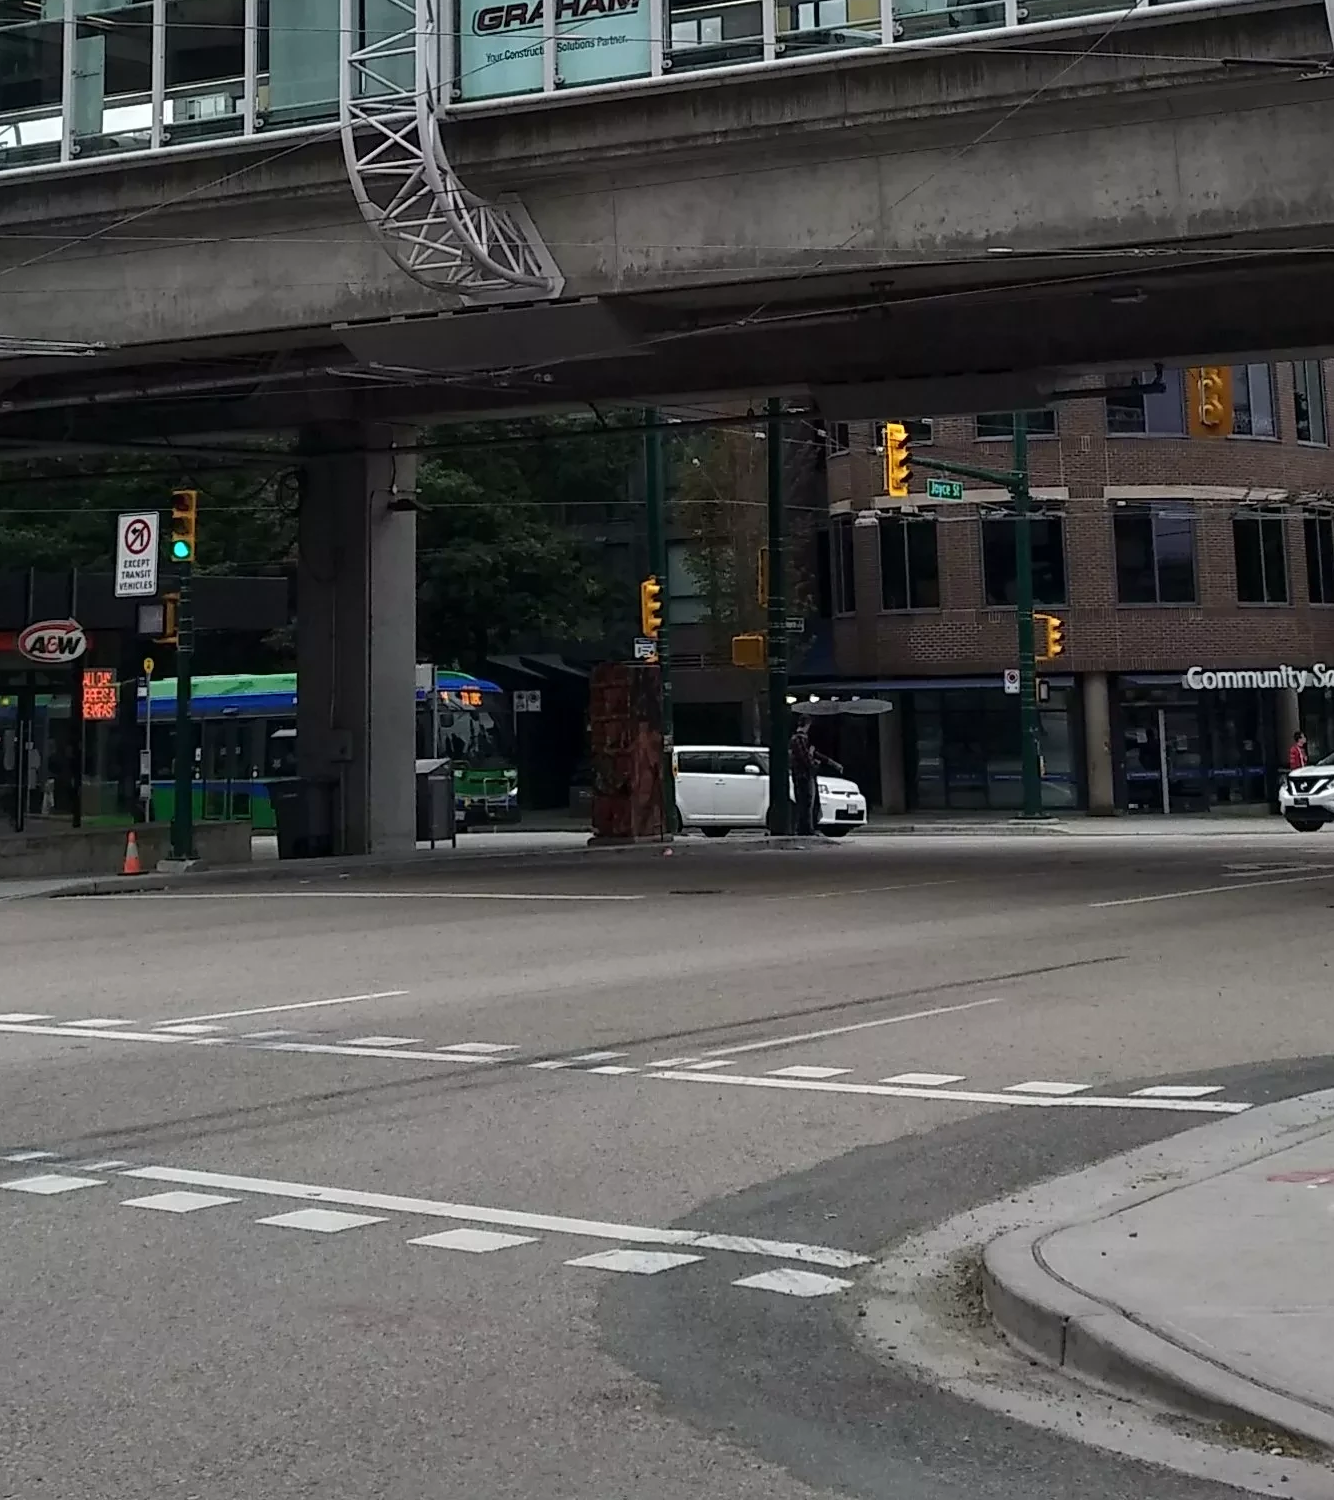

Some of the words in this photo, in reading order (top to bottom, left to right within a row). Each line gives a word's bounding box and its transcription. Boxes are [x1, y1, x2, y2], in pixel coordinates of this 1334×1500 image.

[485, 50, 504, 63] Your
[504, 46, 545, 61] Construct
[556, 38, 595, 53] Solutions
[123, 558, 150, 568] EXCEPT
[121, 569, 152, 580] TRANSIT
[119, 580, 153, 591] VEHICLES
[28, 635, 82, 655] A&W
[1186, 664, 1307, 693] Community
